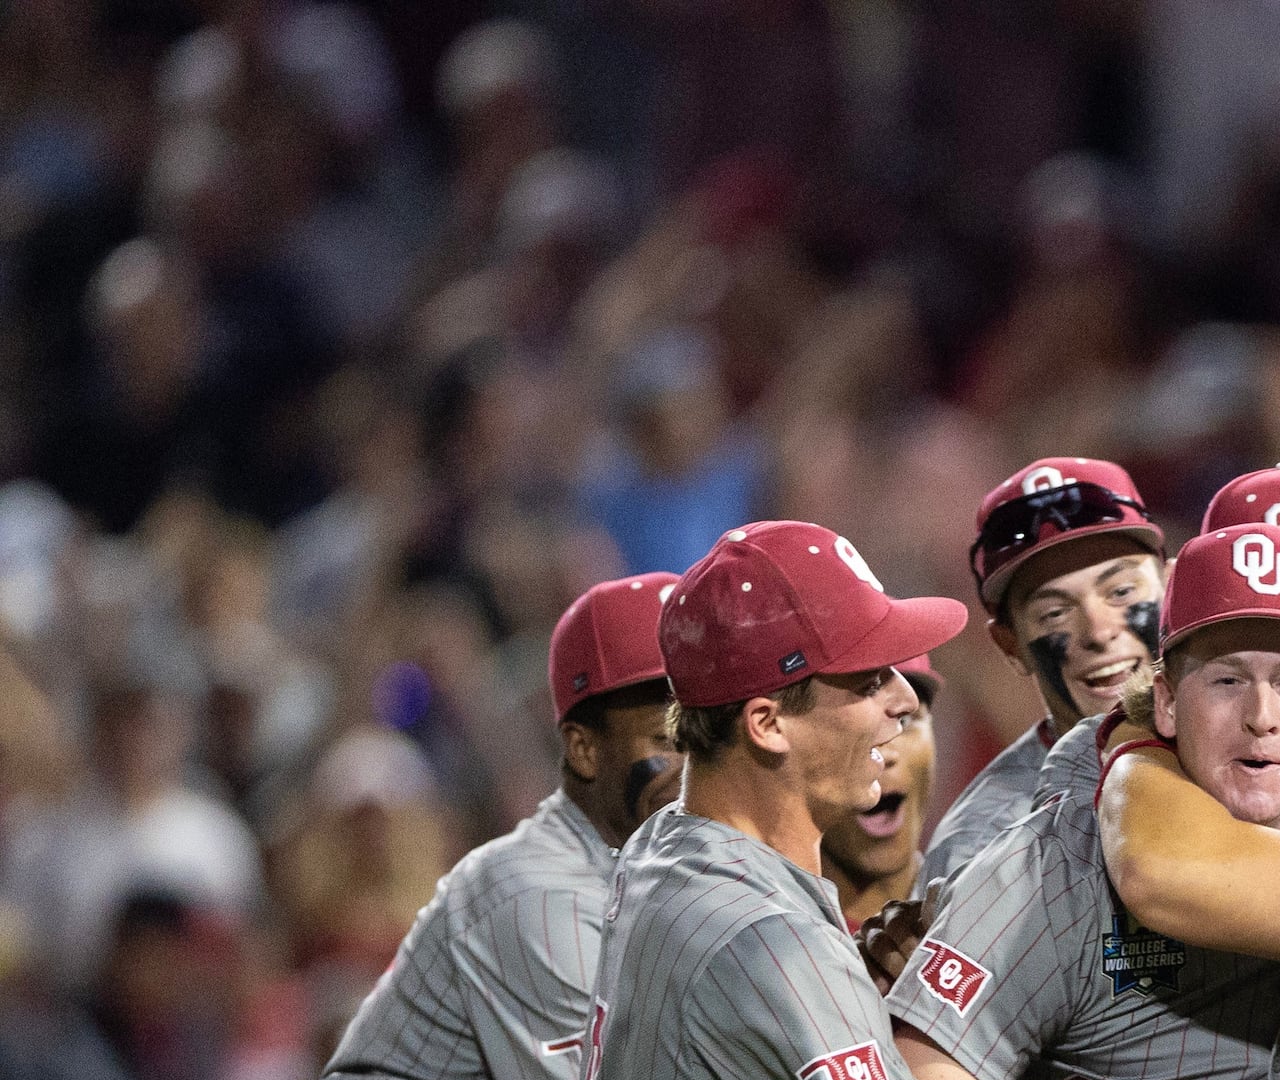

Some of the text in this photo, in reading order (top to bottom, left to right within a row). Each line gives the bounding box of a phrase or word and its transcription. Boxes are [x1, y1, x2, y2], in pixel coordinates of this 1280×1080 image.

[1121, 940, 1168, 956] COLLEGE
[1105, 952, 1184, 972] WORLD SERIES
[938, 959, 963, 990] OU
